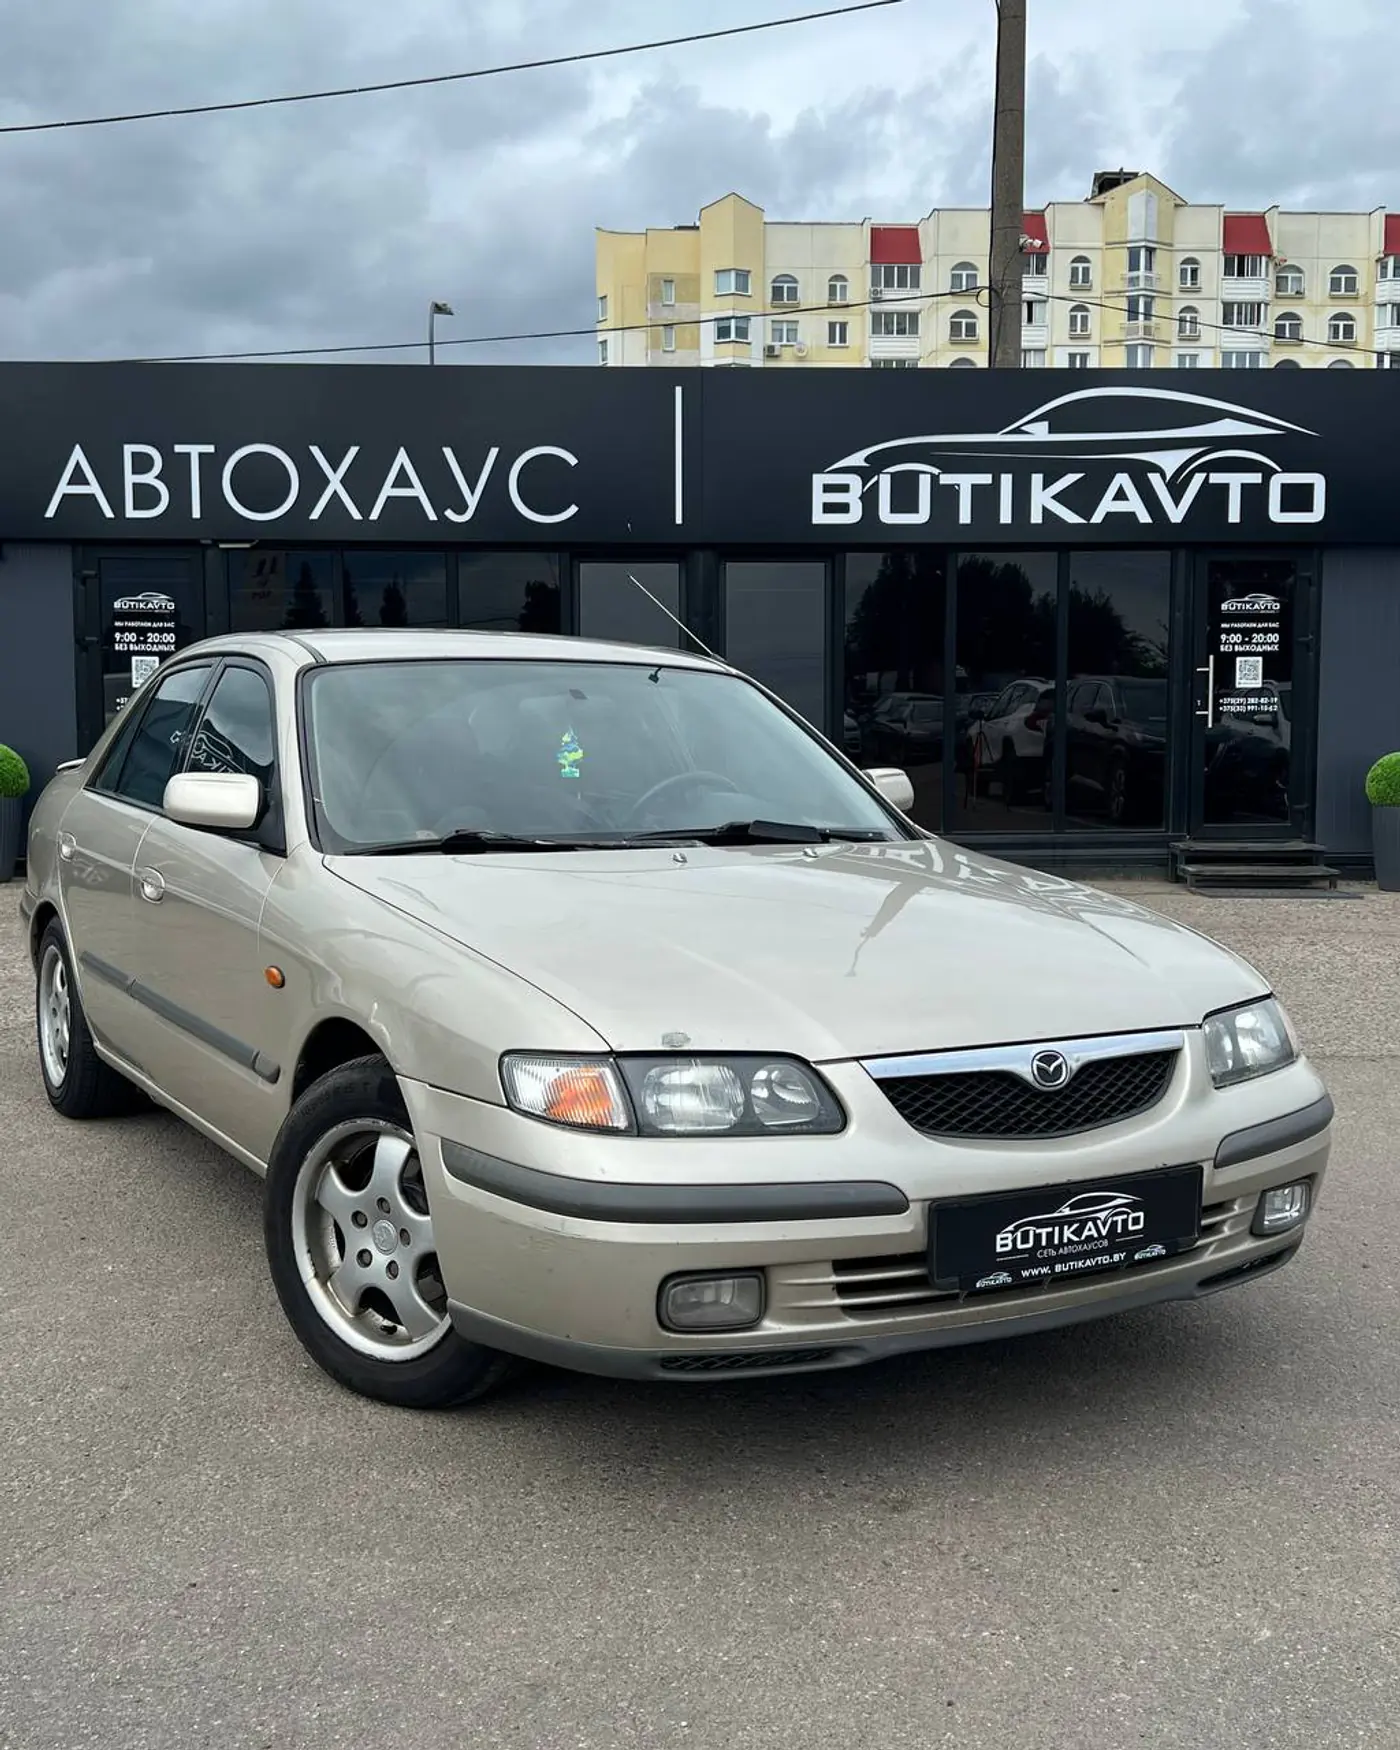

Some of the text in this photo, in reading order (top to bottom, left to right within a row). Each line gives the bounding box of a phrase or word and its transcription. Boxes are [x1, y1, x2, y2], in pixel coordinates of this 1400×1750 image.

[45, 444, 579, 523] АВТОХАУС
[812, 472, 1325, 525] BUTIKAVTO
[113, 601, 175, 610] BUTIKAVTO
[1220, 602, 1280, 610] BUTIKAVTO
[114, 632, 137, 643] 9:00
[146, 632, 176, 643] 20:00
[1220, 633, 1242, 643] 9:00
[1251, 633, 1280, 643] 20:00
[114, 643, 176, 652] БЕЗ ВЫХОДНЫХ
[1220, 644, 1280, 652] БЕЗ ВЫХОДНЫХ
[996, 1211, 1145, 1253] BUTIKAVTO
[1037, 1238, 1109, 1259] СЕТЬ АВТОХАУСОВ
[1021, 1252, 1127, 1278] WWW. BUTIKAVTO.BY
